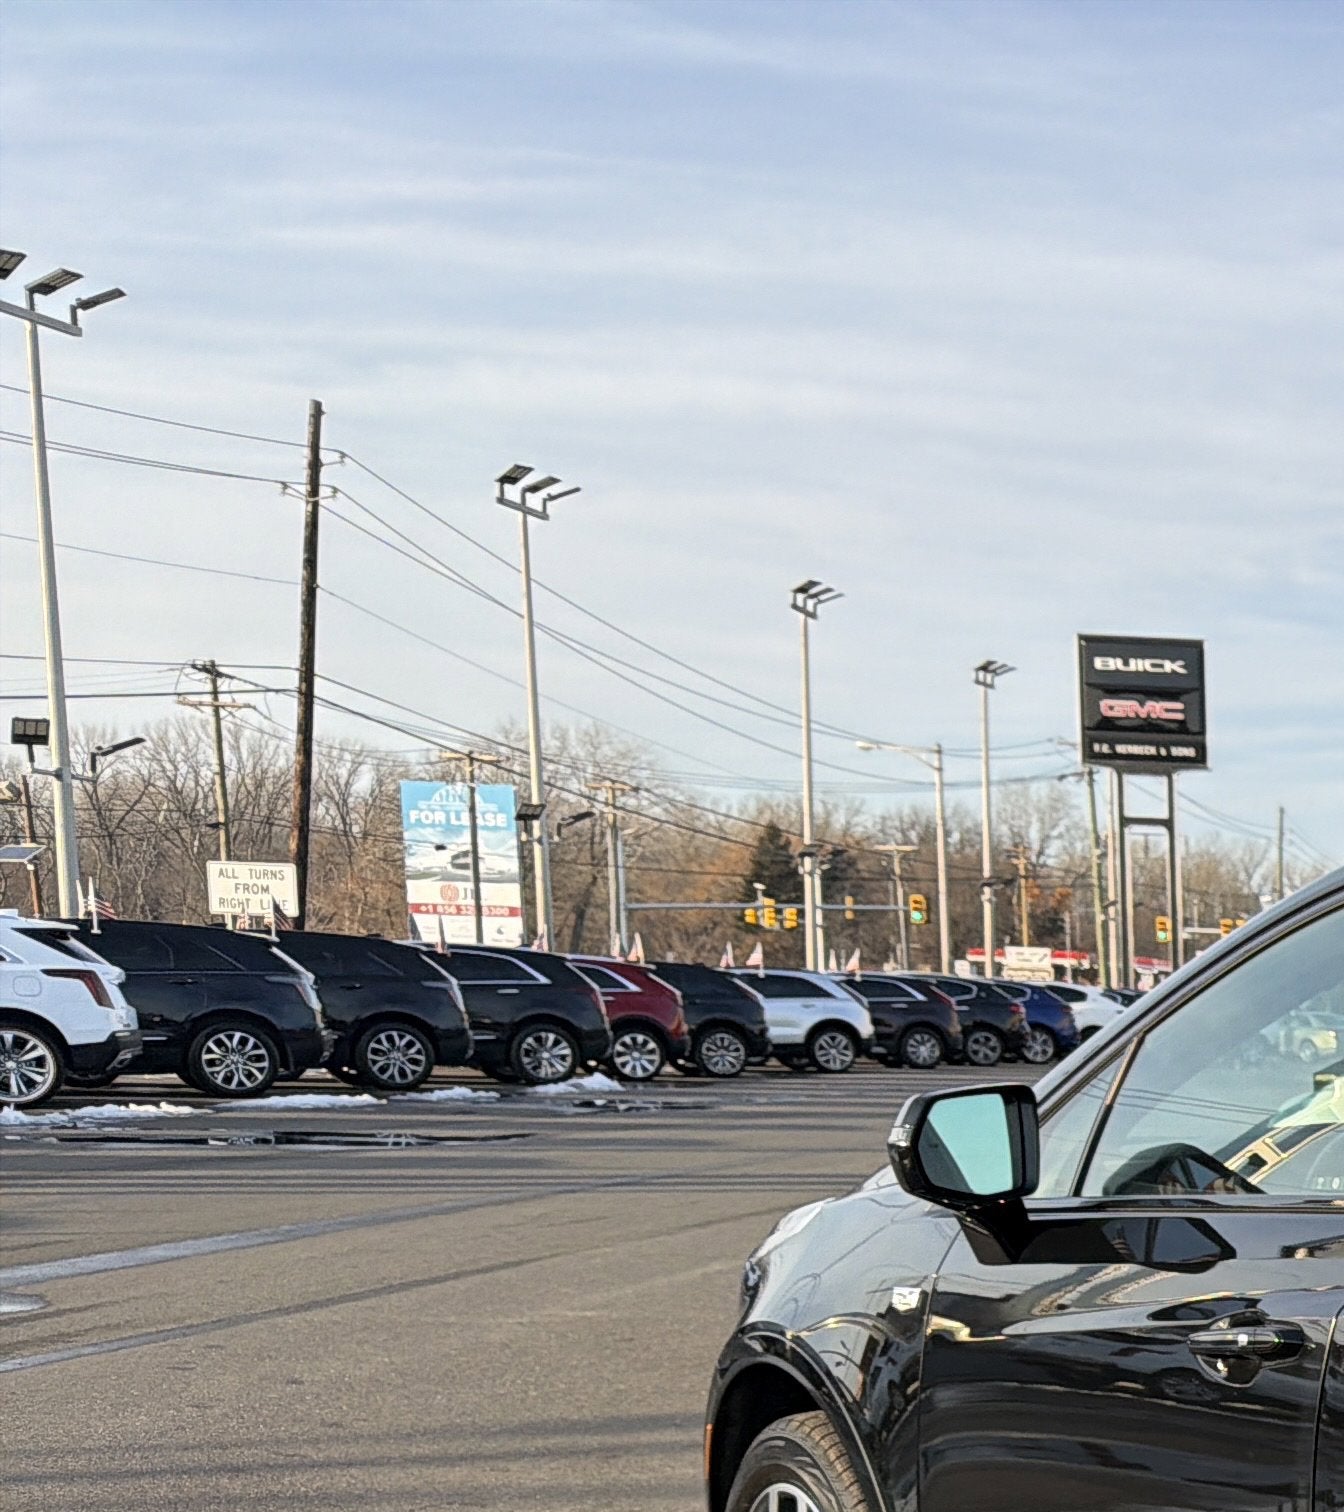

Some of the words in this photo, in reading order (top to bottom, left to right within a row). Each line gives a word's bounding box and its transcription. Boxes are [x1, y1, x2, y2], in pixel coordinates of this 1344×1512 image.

[1093, 656, 1188, 674] BUICK
[1099, 698, 1185, 720] GMC
[409, 809, 446, 825] FOR
[218, 867, 239, 880] ALL
[248, 868, 285, 881] TURNS
[234, 882, 270, 895] FROM
[219, 896, 251, 910] RIGHT
